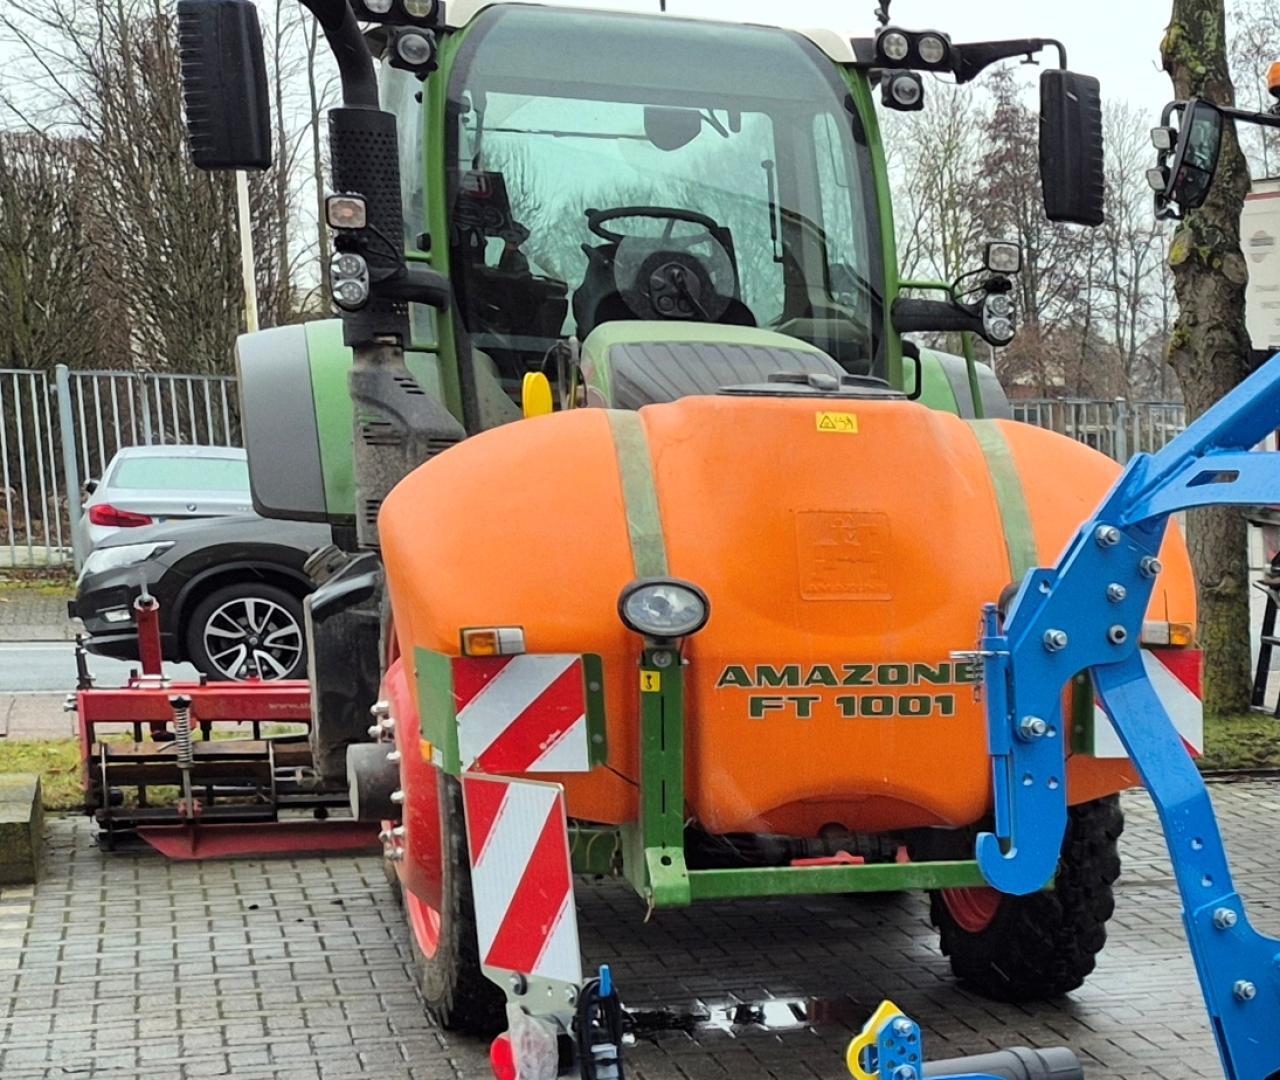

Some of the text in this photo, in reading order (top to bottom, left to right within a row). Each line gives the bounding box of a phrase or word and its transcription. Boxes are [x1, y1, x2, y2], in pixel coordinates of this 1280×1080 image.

[715, 663, 985, 688] AMAZONE
[749, 694, 956, 719] FT 1001
